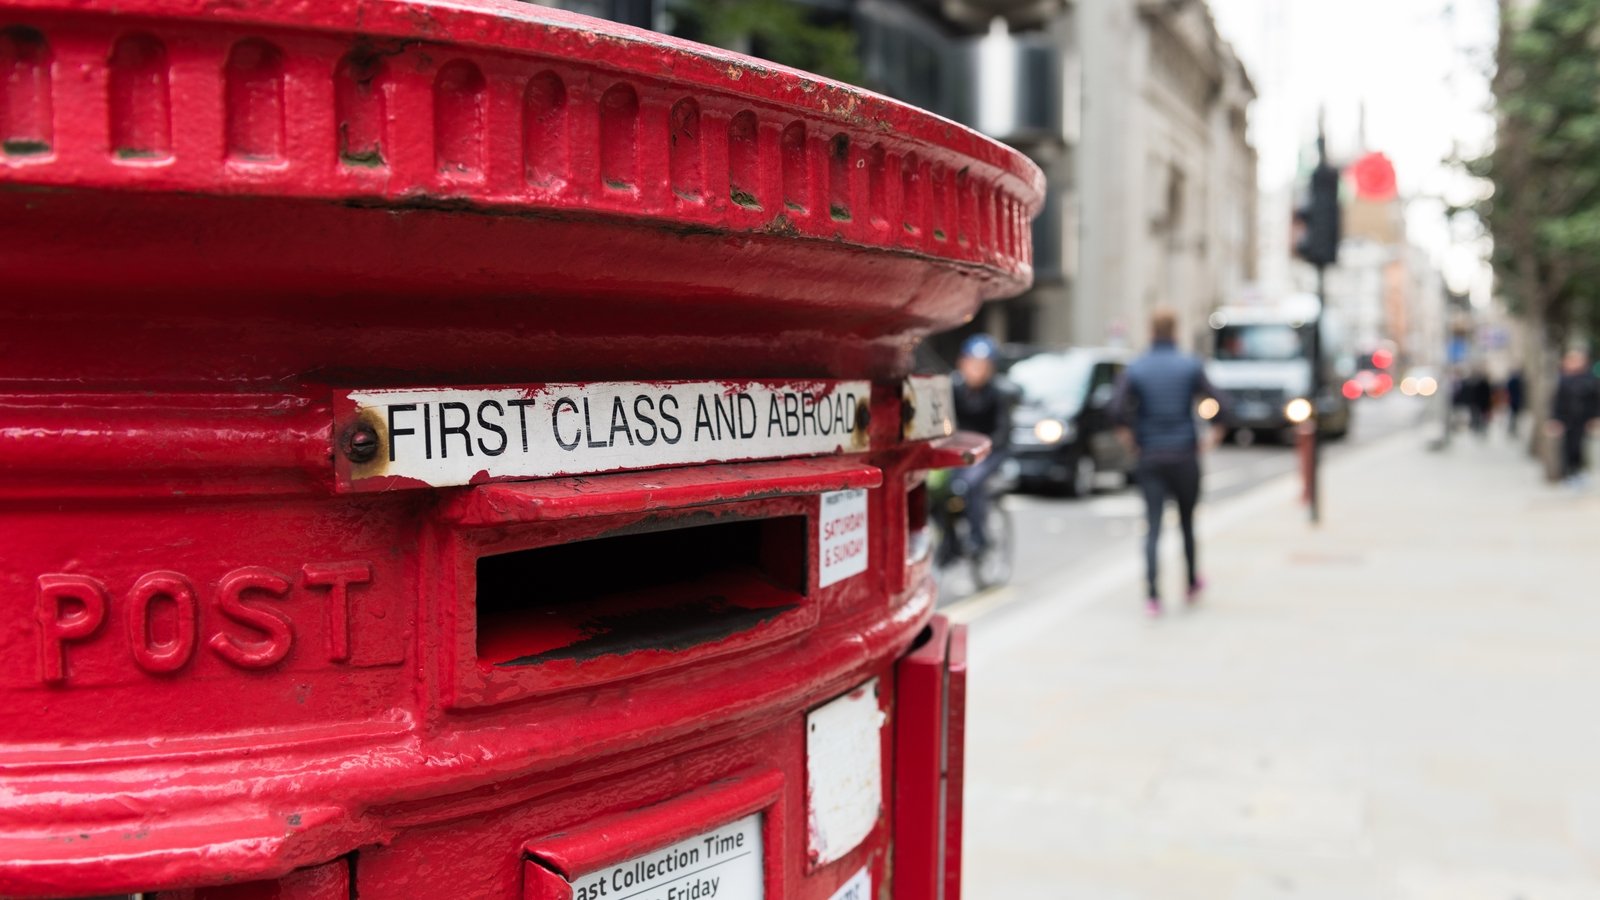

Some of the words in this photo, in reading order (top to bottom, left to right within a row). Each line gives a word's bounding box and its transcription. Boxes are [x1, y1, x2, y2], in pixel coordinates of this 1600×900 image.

[387, 398, 536, 462] FIRST
[552, 393, 682, 452] CLASS
[694, 393, 757, 442] AND
[767, 392, 857, 438] ABROAD
[824, 512, 864, 541] SATURDAY
[833, 538, 864, 564] SUNDAY
[36, 561, 373, 687] POST
[577, 876, 607, 900] ast
[612, 848, 699, 892] Collection
[704, 832, 744, 858] Time
[667, 876, 720, 900] Friday
